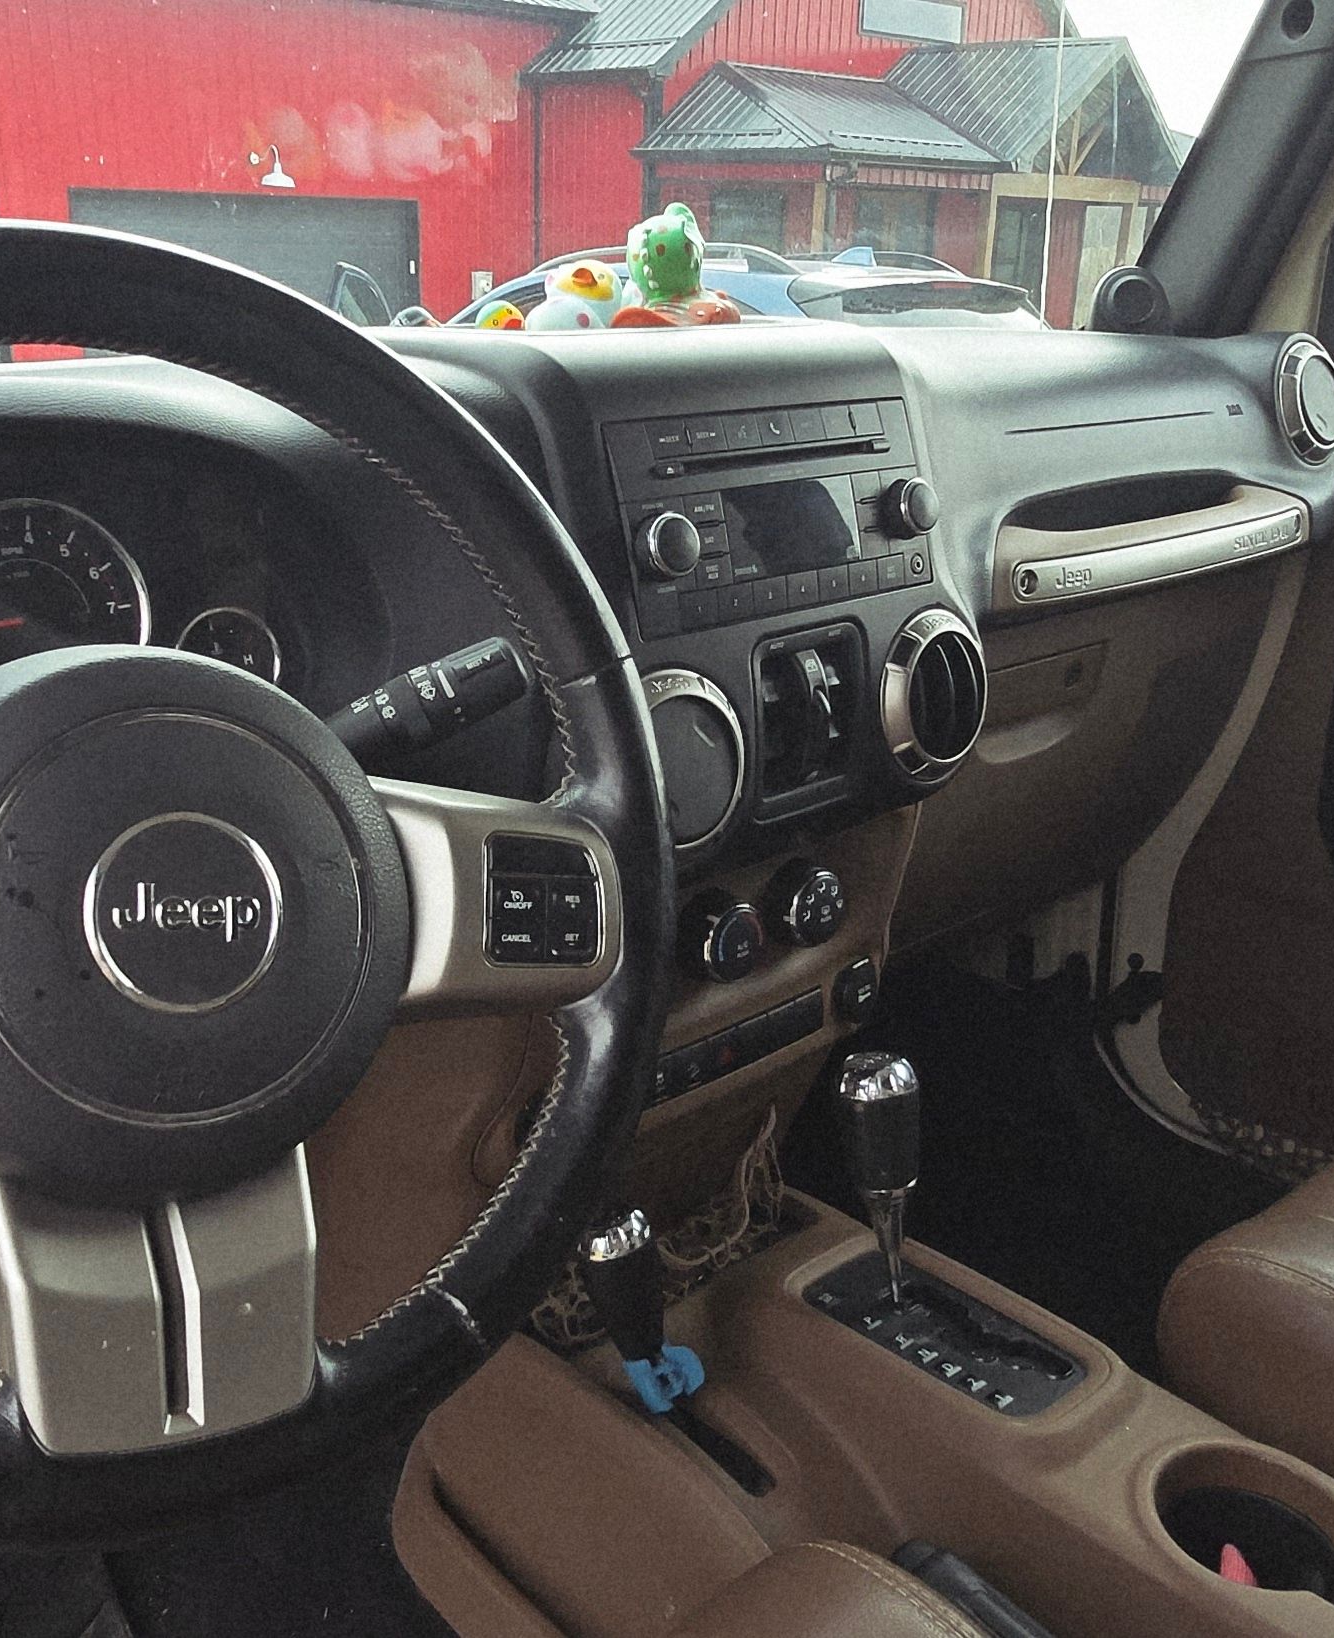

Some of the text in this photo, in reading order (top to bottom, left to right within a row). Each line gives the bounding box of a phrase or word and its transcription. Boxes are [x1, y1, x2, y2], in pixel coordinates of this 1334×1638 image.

[24, 531, 34, 545] 4
[59, 543, 70, 557] 5
[88, 566, 100, 580] 6
[1054, 566, 1092, 591] Jeep
[105, 601, 116, 615] 7
[243, 653, 254, 666] H
[112, 882, 261, 942] Jeep
[501, 934, 532, 943] CANCEL
